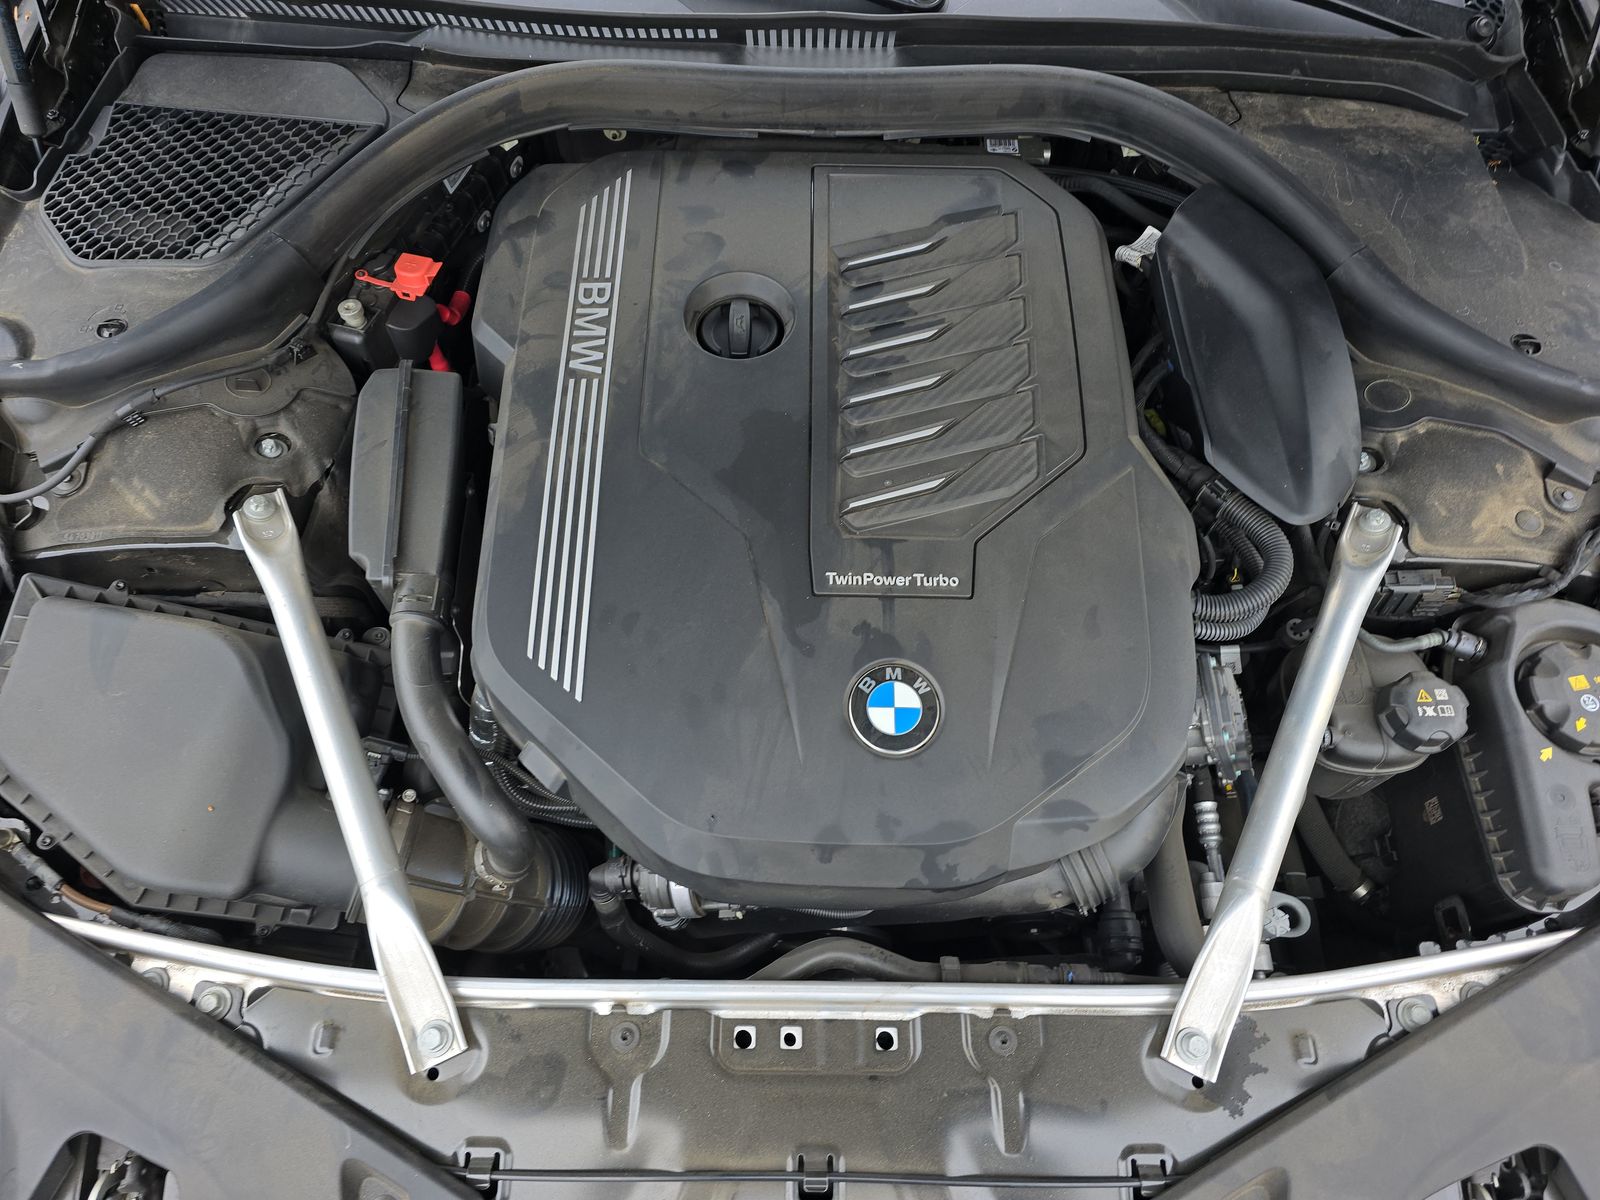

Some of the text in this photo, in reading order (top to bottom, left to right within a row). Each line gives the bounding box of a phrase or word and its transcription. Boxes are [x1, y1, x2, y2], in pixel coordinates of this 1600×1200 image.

[569, 282, 611, 374] BMW
[825, 572, 959, 587] TwinPower Turbo
[858, 667, 931, 695] BMW
